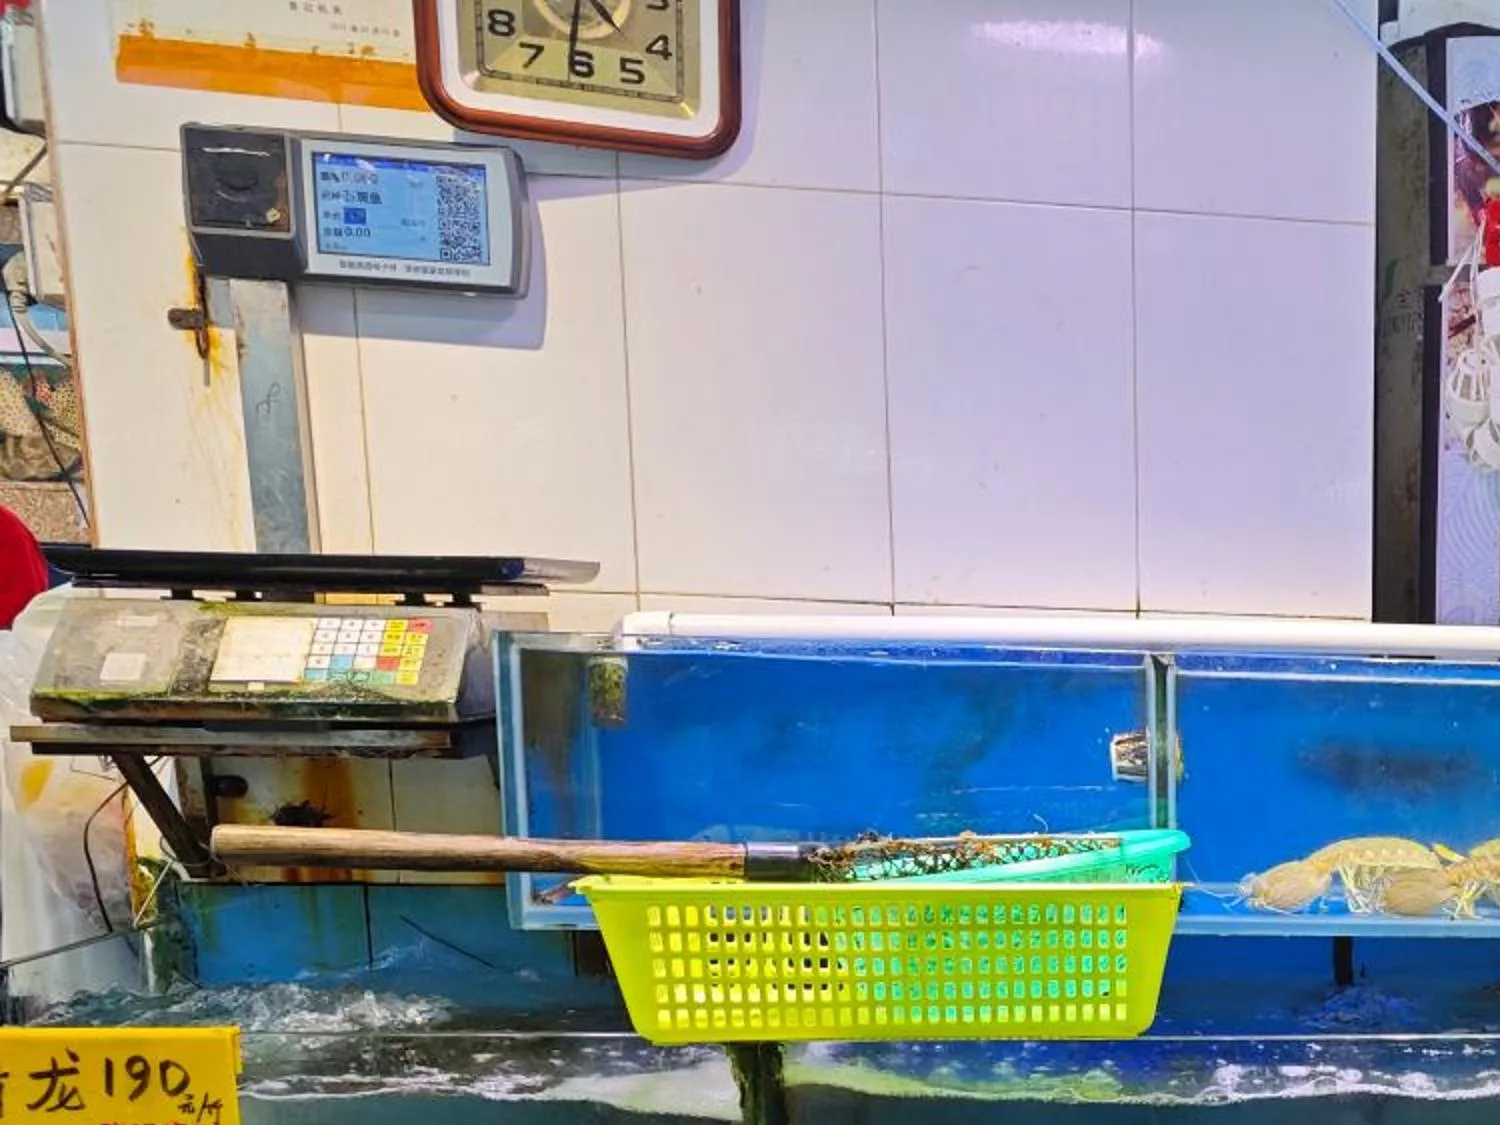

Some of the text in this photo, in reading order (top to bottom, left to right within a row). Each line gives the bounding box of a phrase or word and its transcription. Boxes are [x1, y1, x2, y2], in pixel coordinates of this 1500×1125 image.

[488, 9, 516, 36] 8
[519, 42, 544, 69] 7
[645, 34, 673, 60] 4
[569, 50, 595, 78] 6
[619, 57, 645, 84] 5
[0, 1047, 87, 1118] 龙
